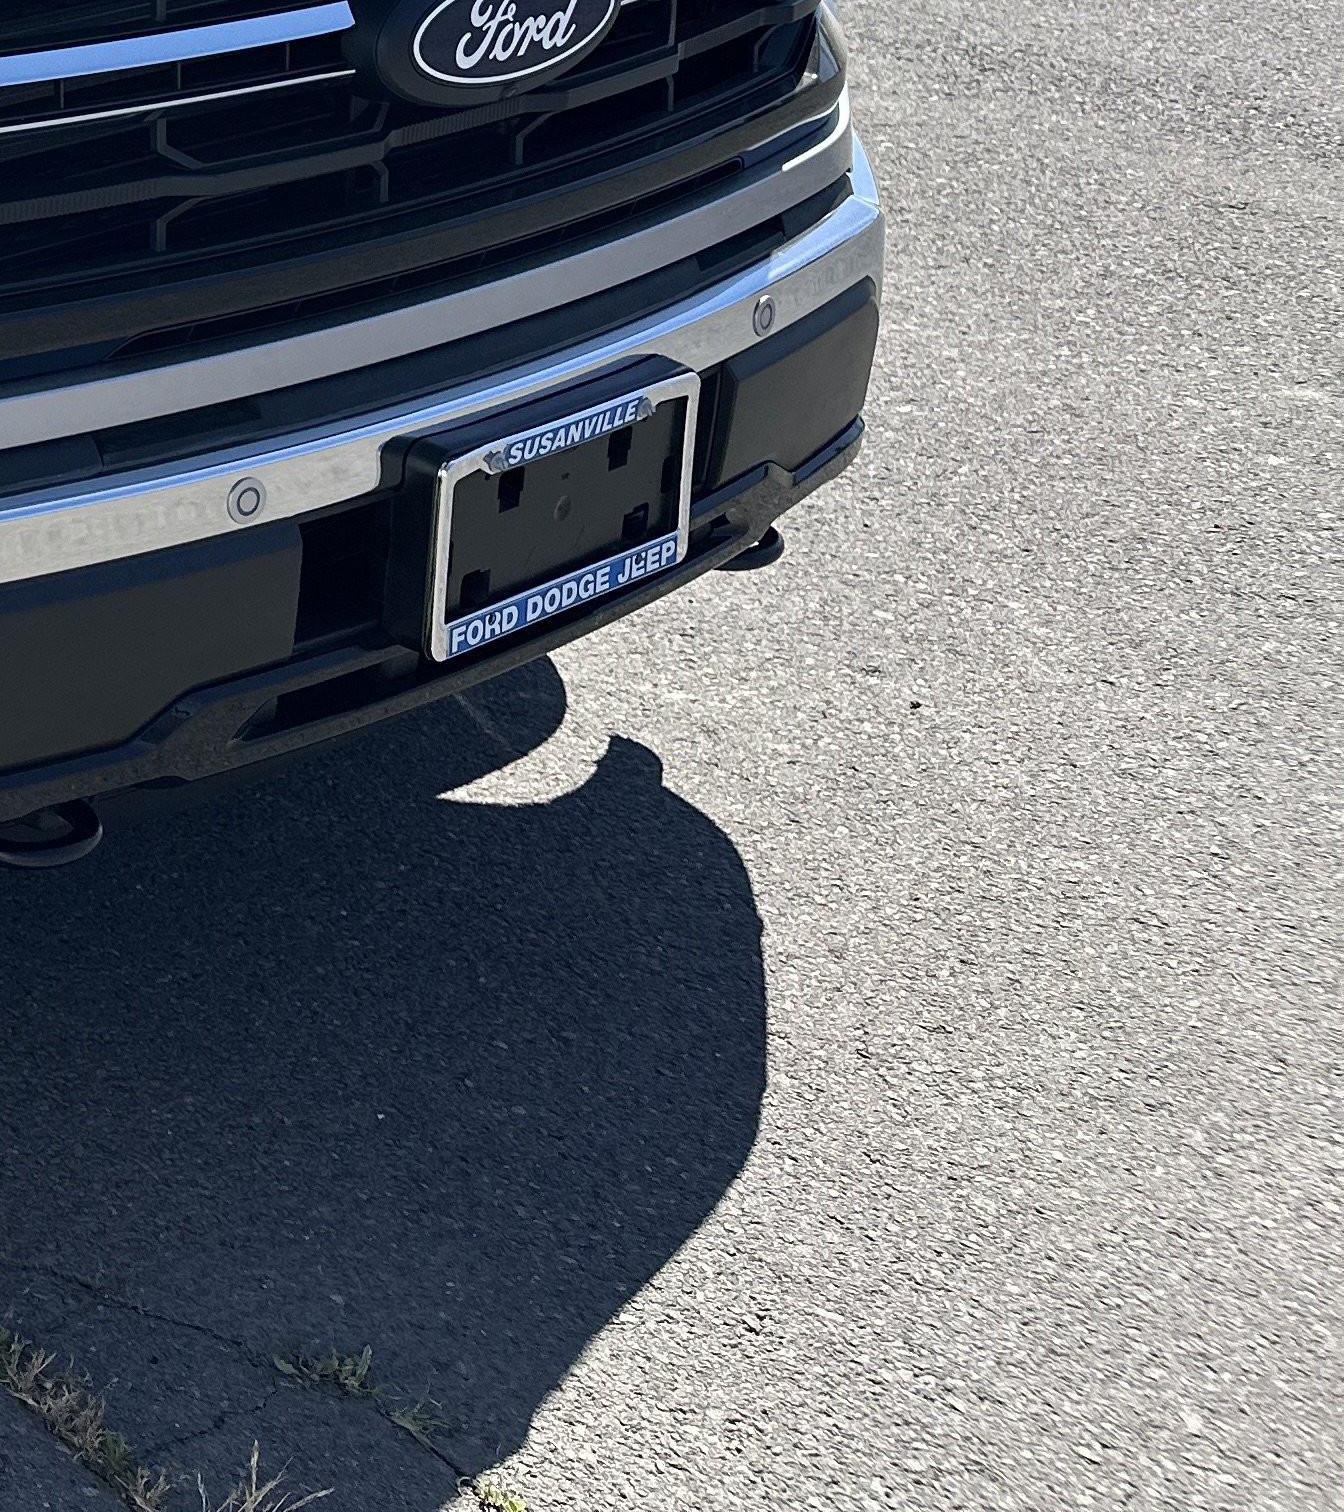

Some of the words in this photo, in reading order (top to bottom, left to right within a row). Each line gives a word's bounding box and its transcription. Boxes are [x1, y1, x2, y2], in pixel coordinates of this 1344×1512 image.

[506, 398, 640, 466] SUSANVILLE
[450, 603, 519, 655] FORD
[526, 564, 611, 624] DODGE
[616, 539, 677, 586] JEEP
